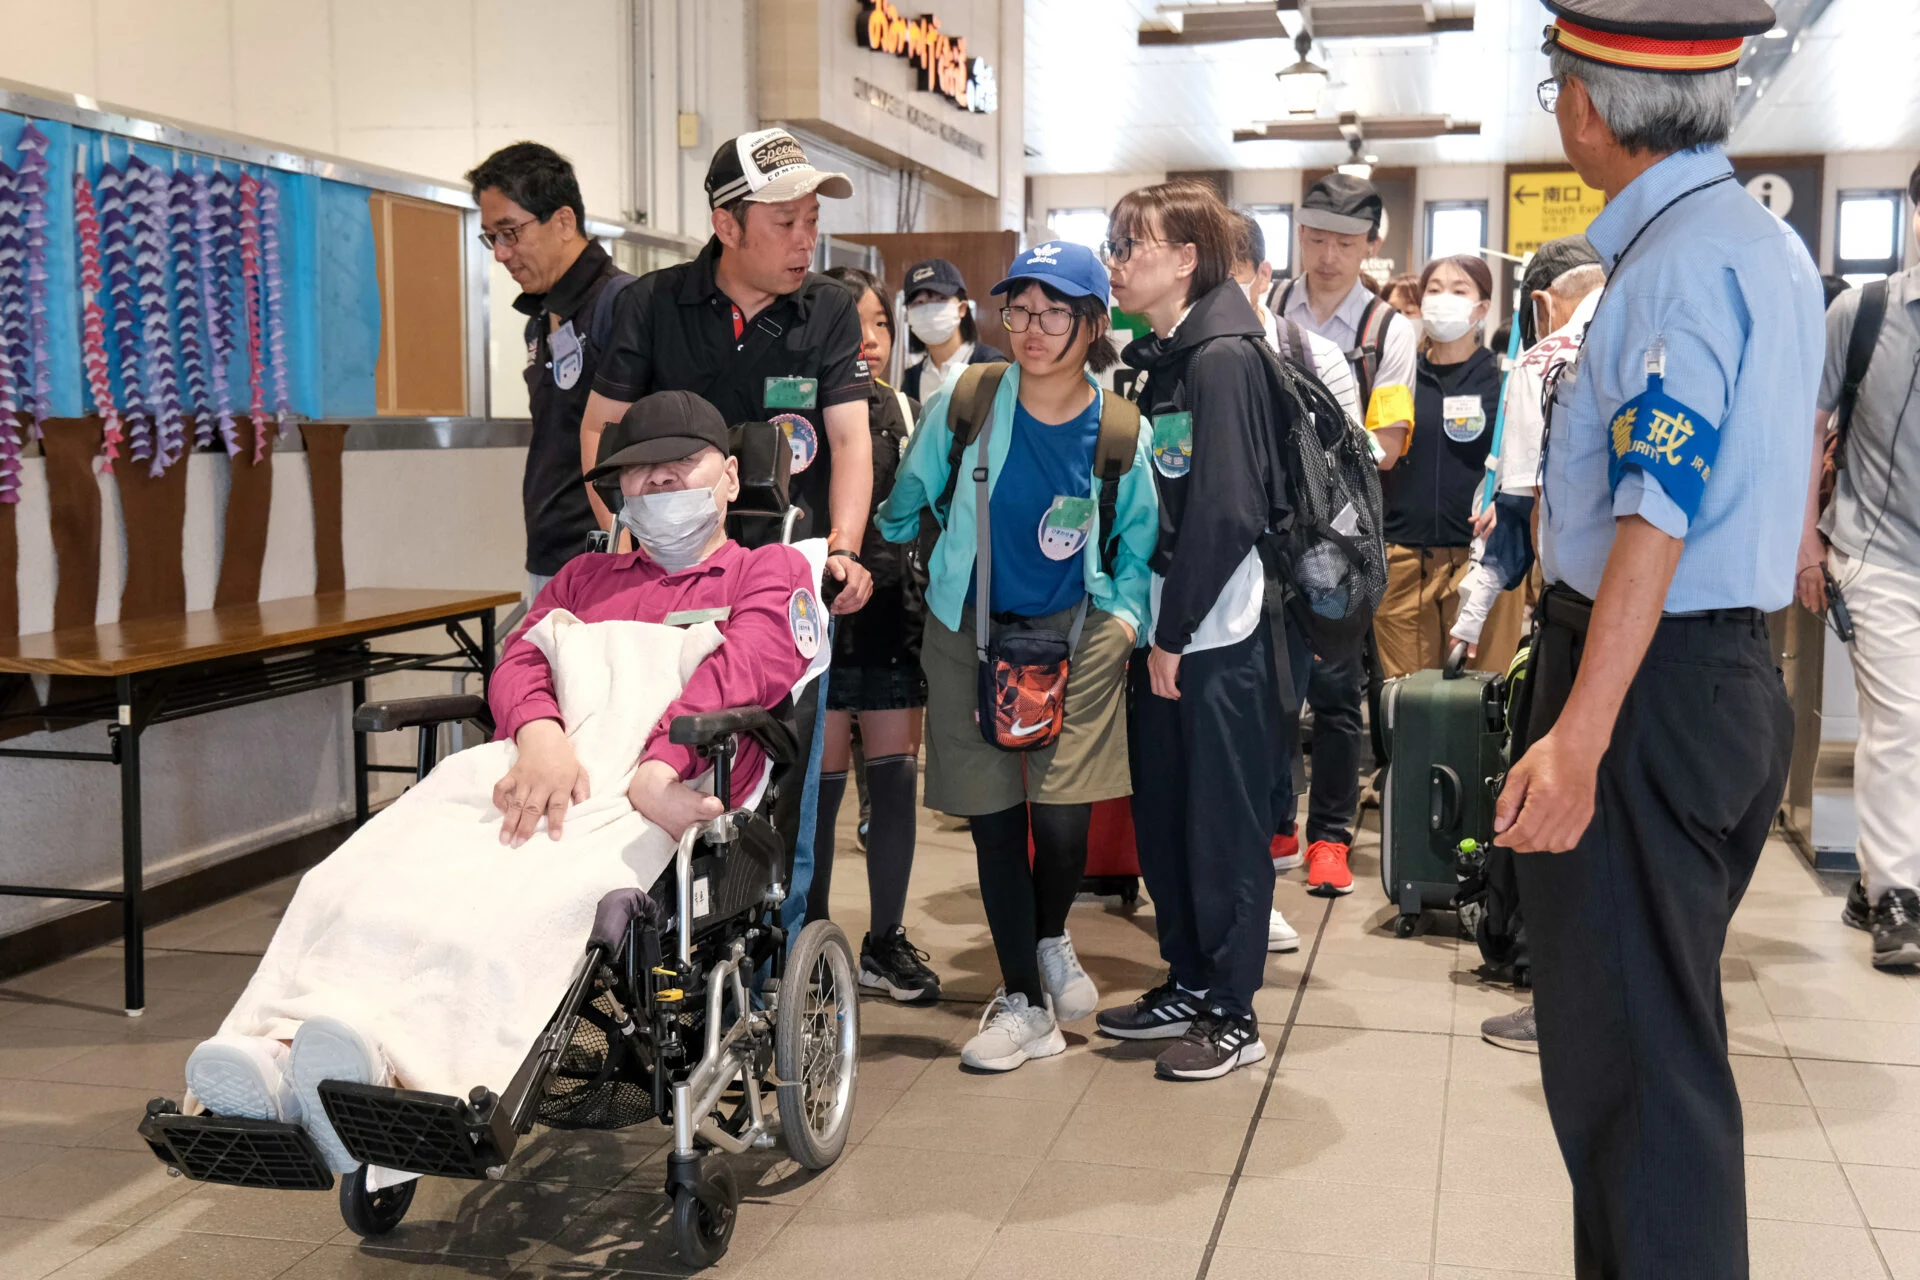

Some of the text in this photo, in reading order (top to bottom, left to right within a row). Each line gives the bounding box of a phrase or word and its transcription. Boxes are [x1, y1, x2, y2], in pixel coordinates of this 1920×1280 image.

[755, 142, 795, 165] Speed
[1543, 186, 1581, 203] 南口
[1542, 205, 1600, 216] South Exit
[1026, 256, 1058, 265] adidas
[1360, 257, 1395, 271] ation
